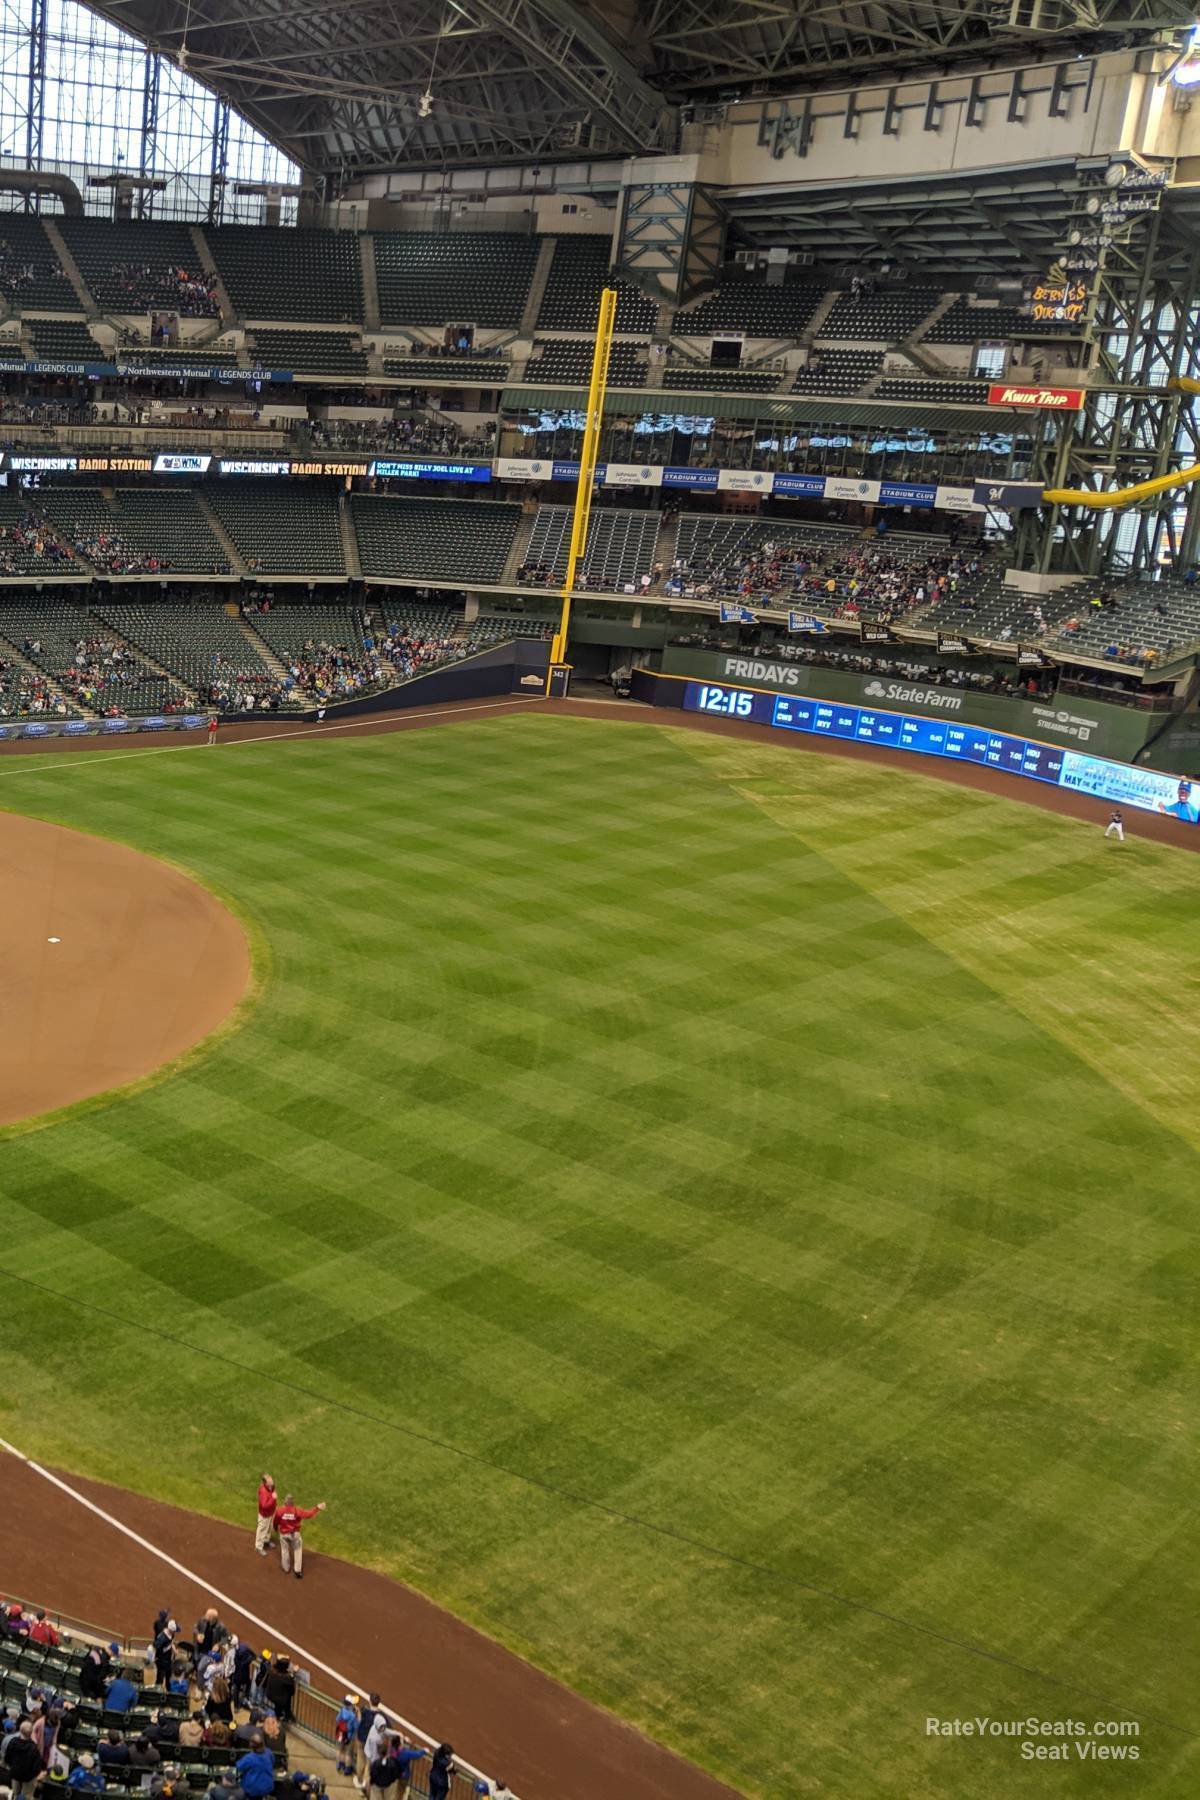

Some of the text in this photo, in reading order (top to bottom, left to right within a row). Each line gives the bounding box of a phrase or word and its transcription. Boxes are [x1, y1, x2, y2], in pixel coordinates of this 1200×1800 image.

[0, 362, 28, 372] Mutual
[34, 364, 65, 372] LEGENDS
[66, 365, 85, 373] CLUB
[127, 366, 272, 380] Northwestern Mutual LEGENDS CLUB
[12, 457, 152, 471] WISCONSIN'S RADIO STATION
[220, 460, 367, 476] WISCONSIN'S RADIO STATION
[774, 480, 824, 490] STADIUM CLUB
[882, 489, 934, 500] STADIUM CLUB
[724, 658, 802, 686] FRIDAYS
[700, 686, 754, 716] 12:15
[1037, 720, 1069, 733] STREAMING
[949, 730, 964, 740] TOR
[987, 752, 1000, 761] TEX
[1026, 749, 1040, 758] HOU
[1024, 762, 1038, 771] OAK
[1064, 774, 1083, 786] MAY
